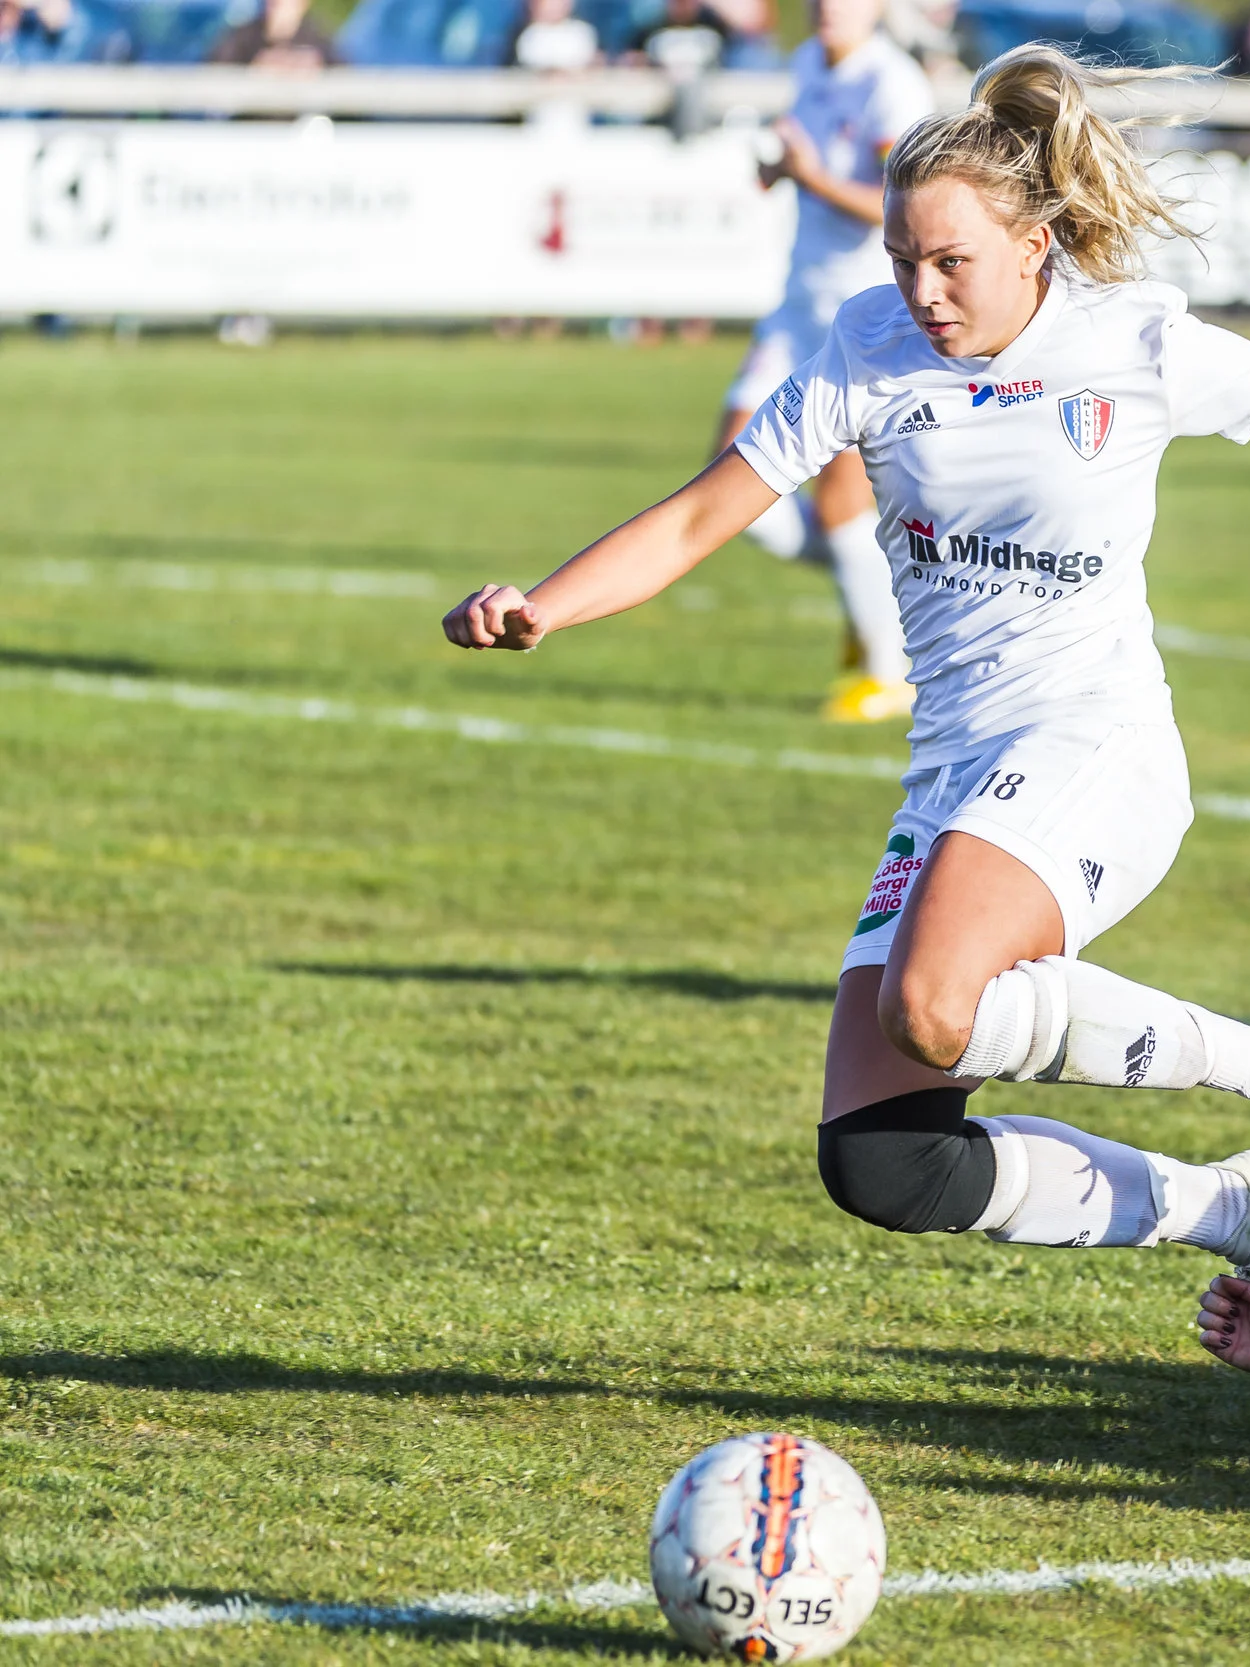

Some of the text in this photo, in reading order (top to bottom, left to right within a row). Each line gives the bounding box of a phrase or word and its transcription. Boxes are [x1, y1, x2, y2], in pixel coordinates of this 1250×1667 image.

[995, 380, 1043, 395] INTER
[898, 421, 941, 434] adidas
[948, 534, 1103, 583] Midhage
[912, 566, 1002, 596] DIAMOND
[976, 769, 1025, 800] 18
[1079, 858, 1095, 904] adidas
